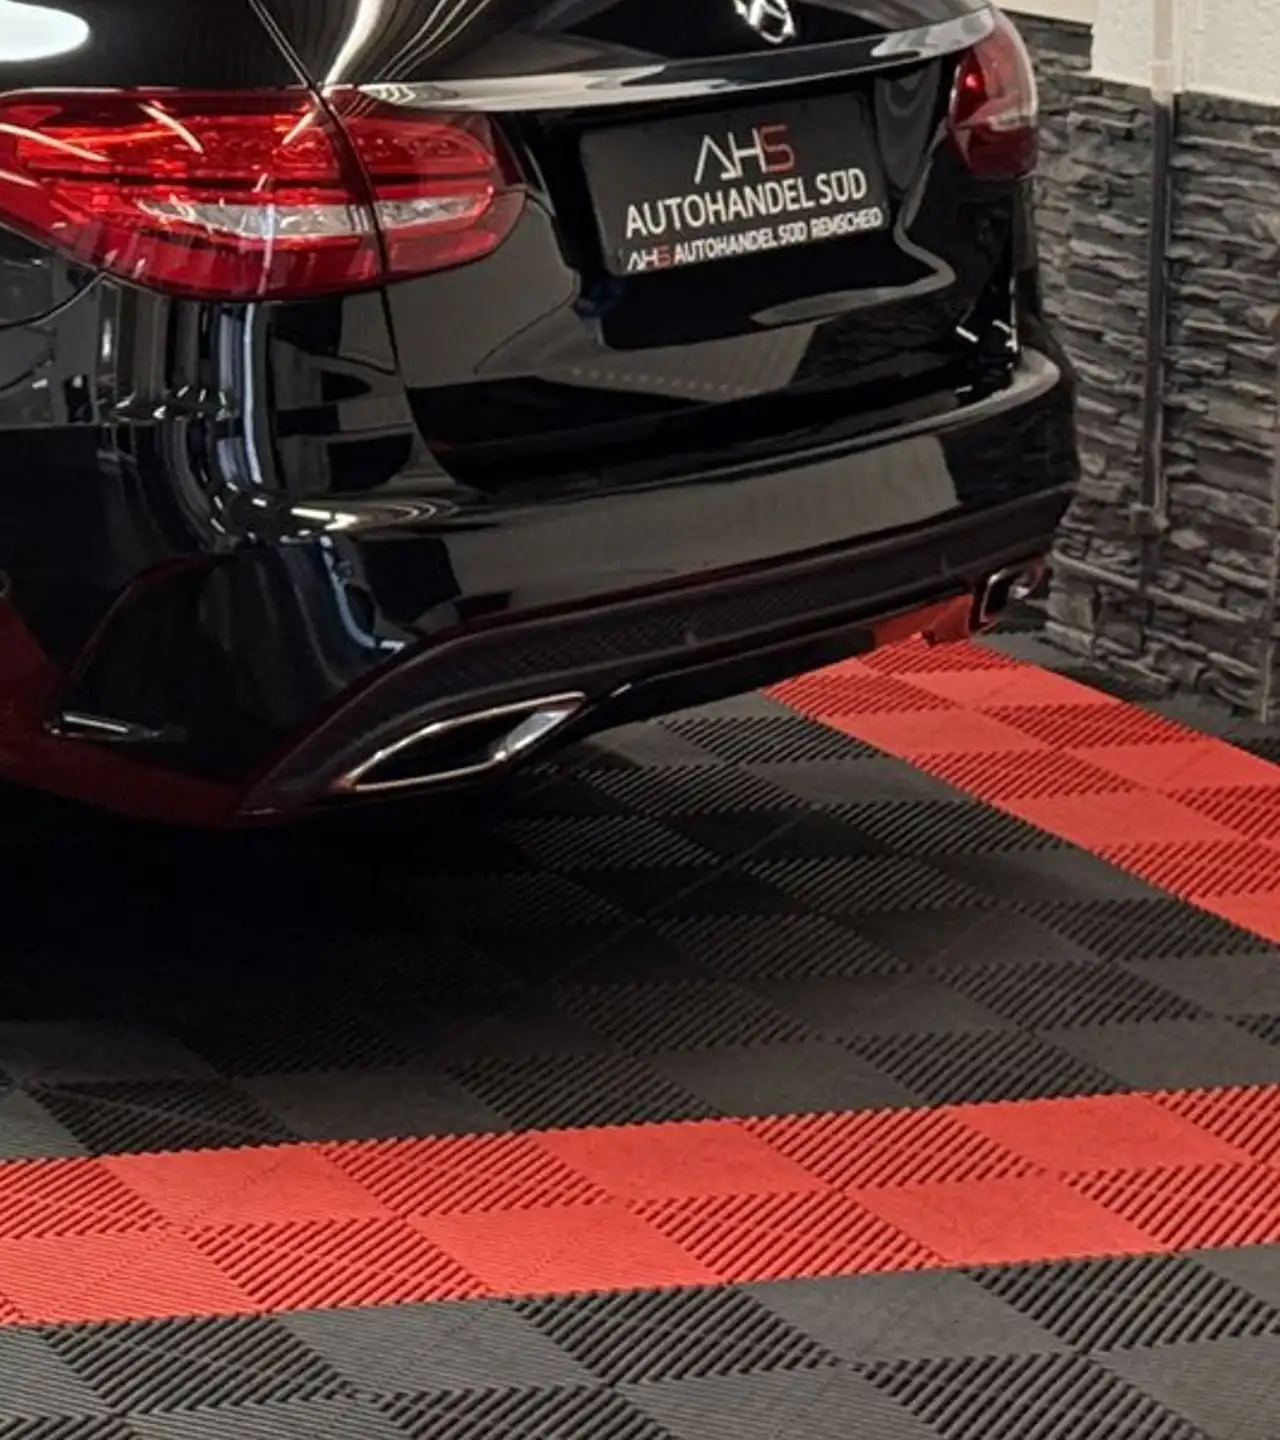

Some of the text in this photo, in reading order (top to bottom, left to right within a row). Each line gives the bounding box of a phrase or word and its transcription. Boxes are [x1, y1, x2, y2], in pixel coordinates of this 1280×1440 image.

[693, 124, 796, 185] AHS
[625, 167, 868, 240] AUTOHANDEL SÜD
[674, 230, 779, 265] AUTOHANDEL
[809, 206, 884, 239] REMSCHEID
